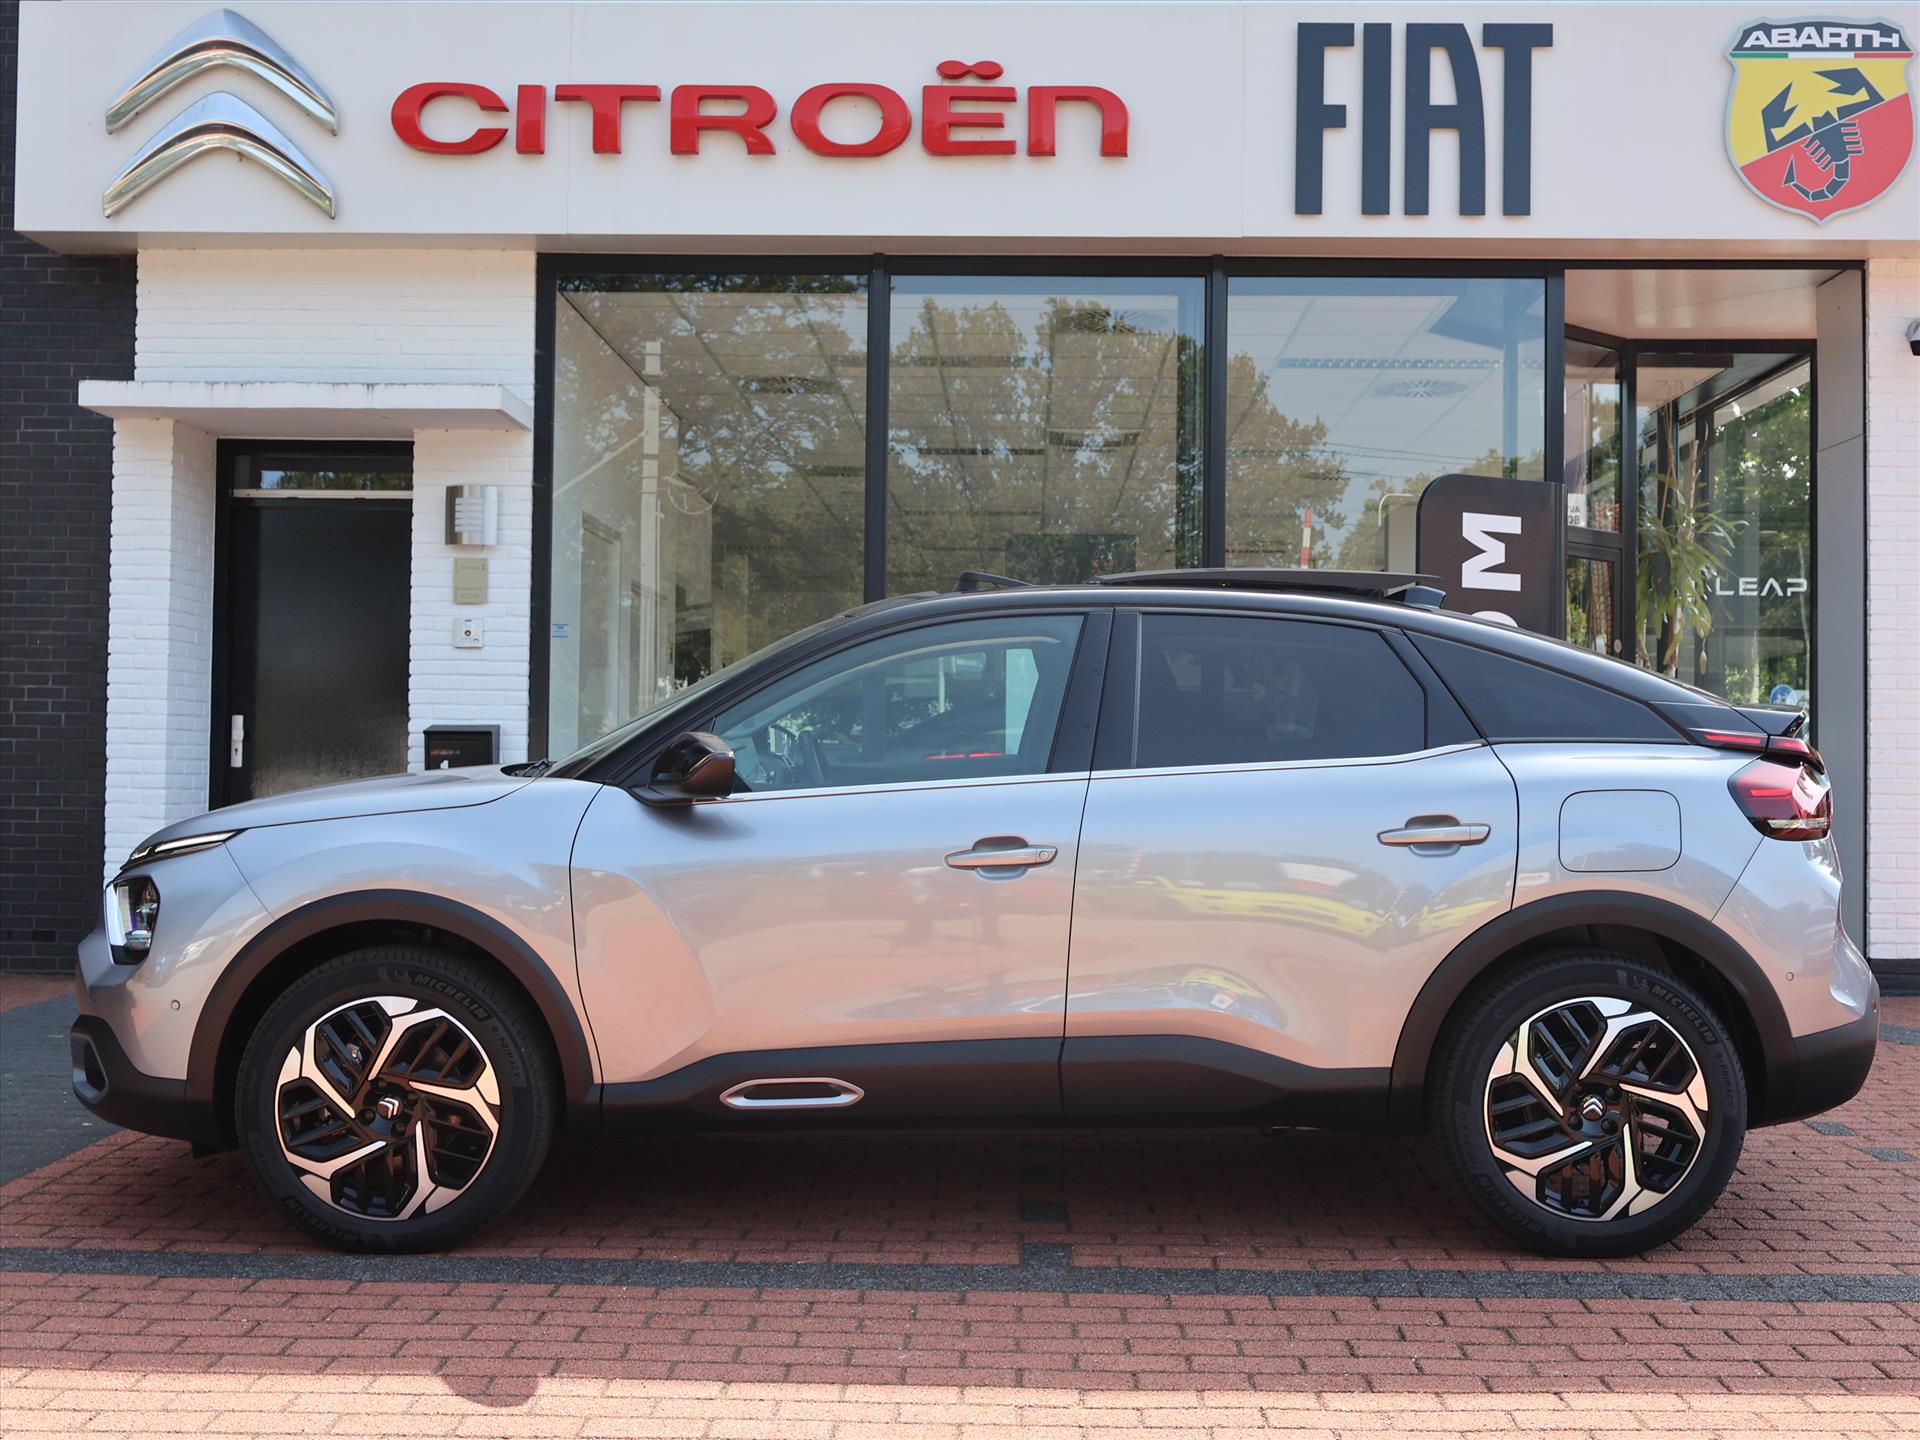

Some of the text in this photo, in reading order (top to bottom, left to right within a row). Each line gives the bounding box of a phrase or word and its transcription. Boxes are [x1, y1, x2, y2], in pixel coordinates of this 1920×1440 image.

[1743, 26, 1900, 49] ABARTH
[391, 60, 1129, 158] CITROËN
[1295, 22, 1553, 216] FIAT
[1462, 512, 1522, 628] M
[1715, 577, 1808, 596] LEAP
[413, 973, 491, 1022] MICHELIN
[1651, 985, 1718, 1045] MICHELIN
